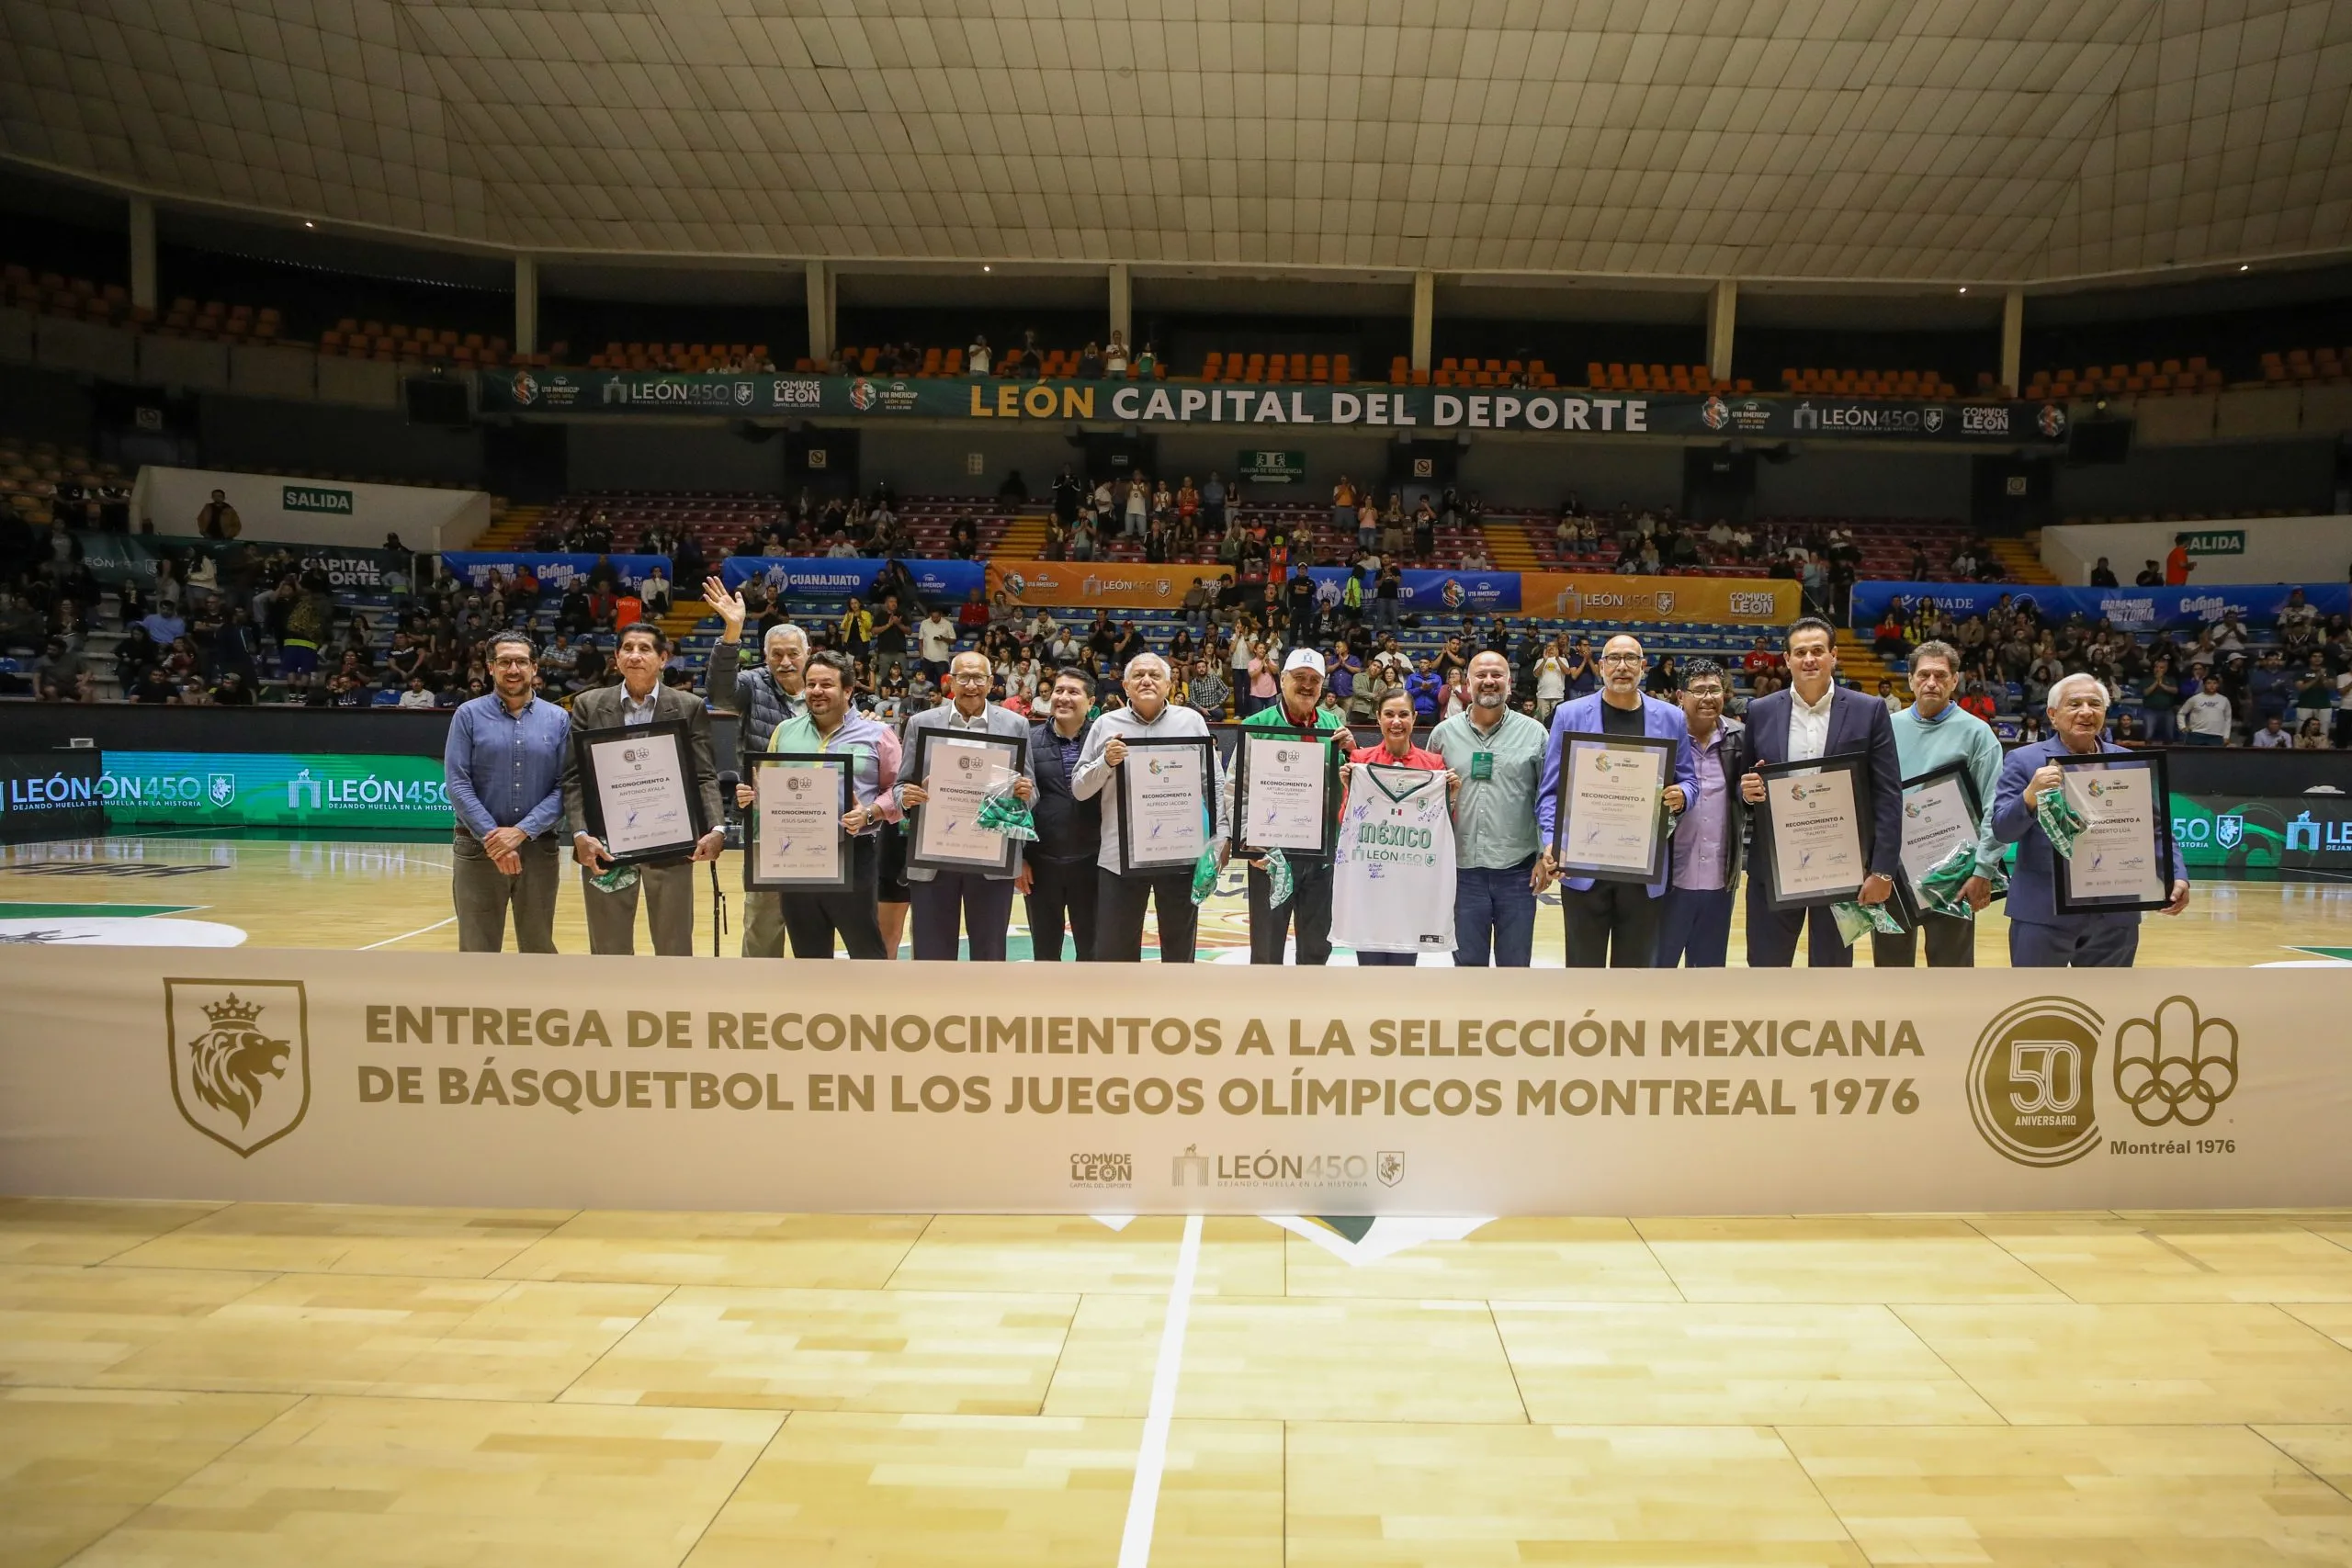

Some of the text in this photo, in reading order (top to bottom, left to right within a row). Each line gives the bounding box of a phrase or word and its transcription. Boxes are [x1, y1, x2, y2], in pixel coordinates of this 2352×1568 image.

[970, 378, 1647, 432] LEÓN CAPITAL DEL DEPORTE
[287, 491, 349, 509] SALIDA
[2188, 536, 2242, 550] ALIDA
[789, 574, 860, 585] GUANAJUATO
[611, 777, 664, 790] RECONOCIMIENTO
[620, 787, 646, 797] ANTONIO
[1581, 792, 1639, 802] RECONOCIMIENTO
[13, 803, 52, 811] DEJANDO
[1785, 817, 1838, 828] RECONOCIMIENTO
[1359, 819, 1431, 849] MÉXICO
[1907, 827, 1955, 846] RECONOCIMIENTO
[367, 1005, 1926, 1057] ENTREGA DE RECONOCIMIENTOS A LA SELECCIÓN MEXICANA
[2009, 1040, 2082, 1113] 50
[357, 1056, 1920, 1116] DE BÁSQUETBOL EN LOS JUEGOS OLÍMPICOS MONTREAL 1976
[2015, 1115, 2076, 1126] ANIVERSARIO
[2110, 1139, 2235, 1155] Montréal 1976
